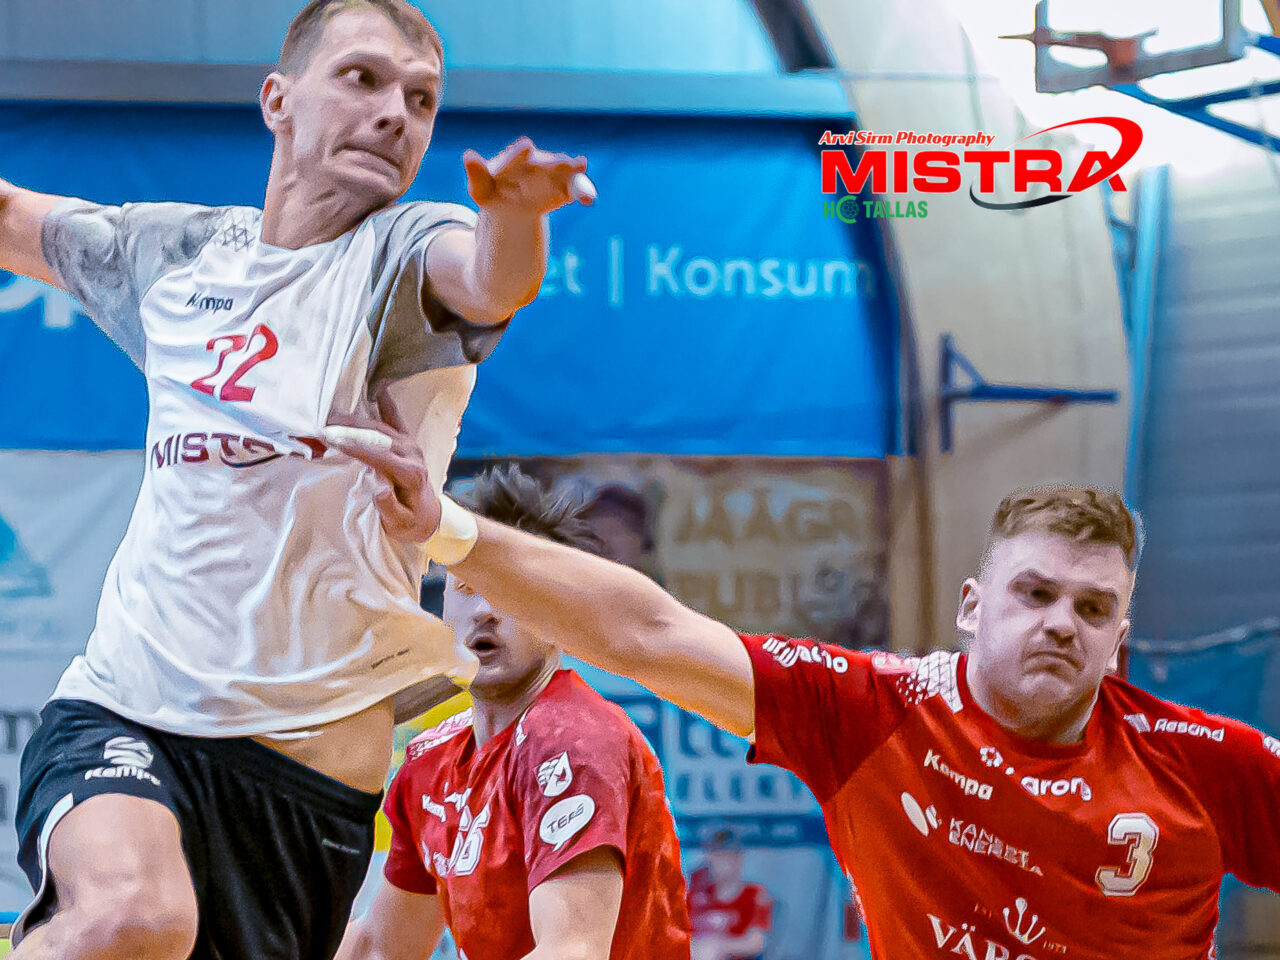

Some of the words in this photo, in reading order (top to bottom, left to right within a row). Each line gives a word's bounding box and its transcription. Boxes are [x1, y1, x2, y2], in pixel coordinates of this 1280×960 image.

[648, 257, 870, 298] Konsum
[190, 323, 279, 403] 22
[1095, 812, 1160, 897] 3
